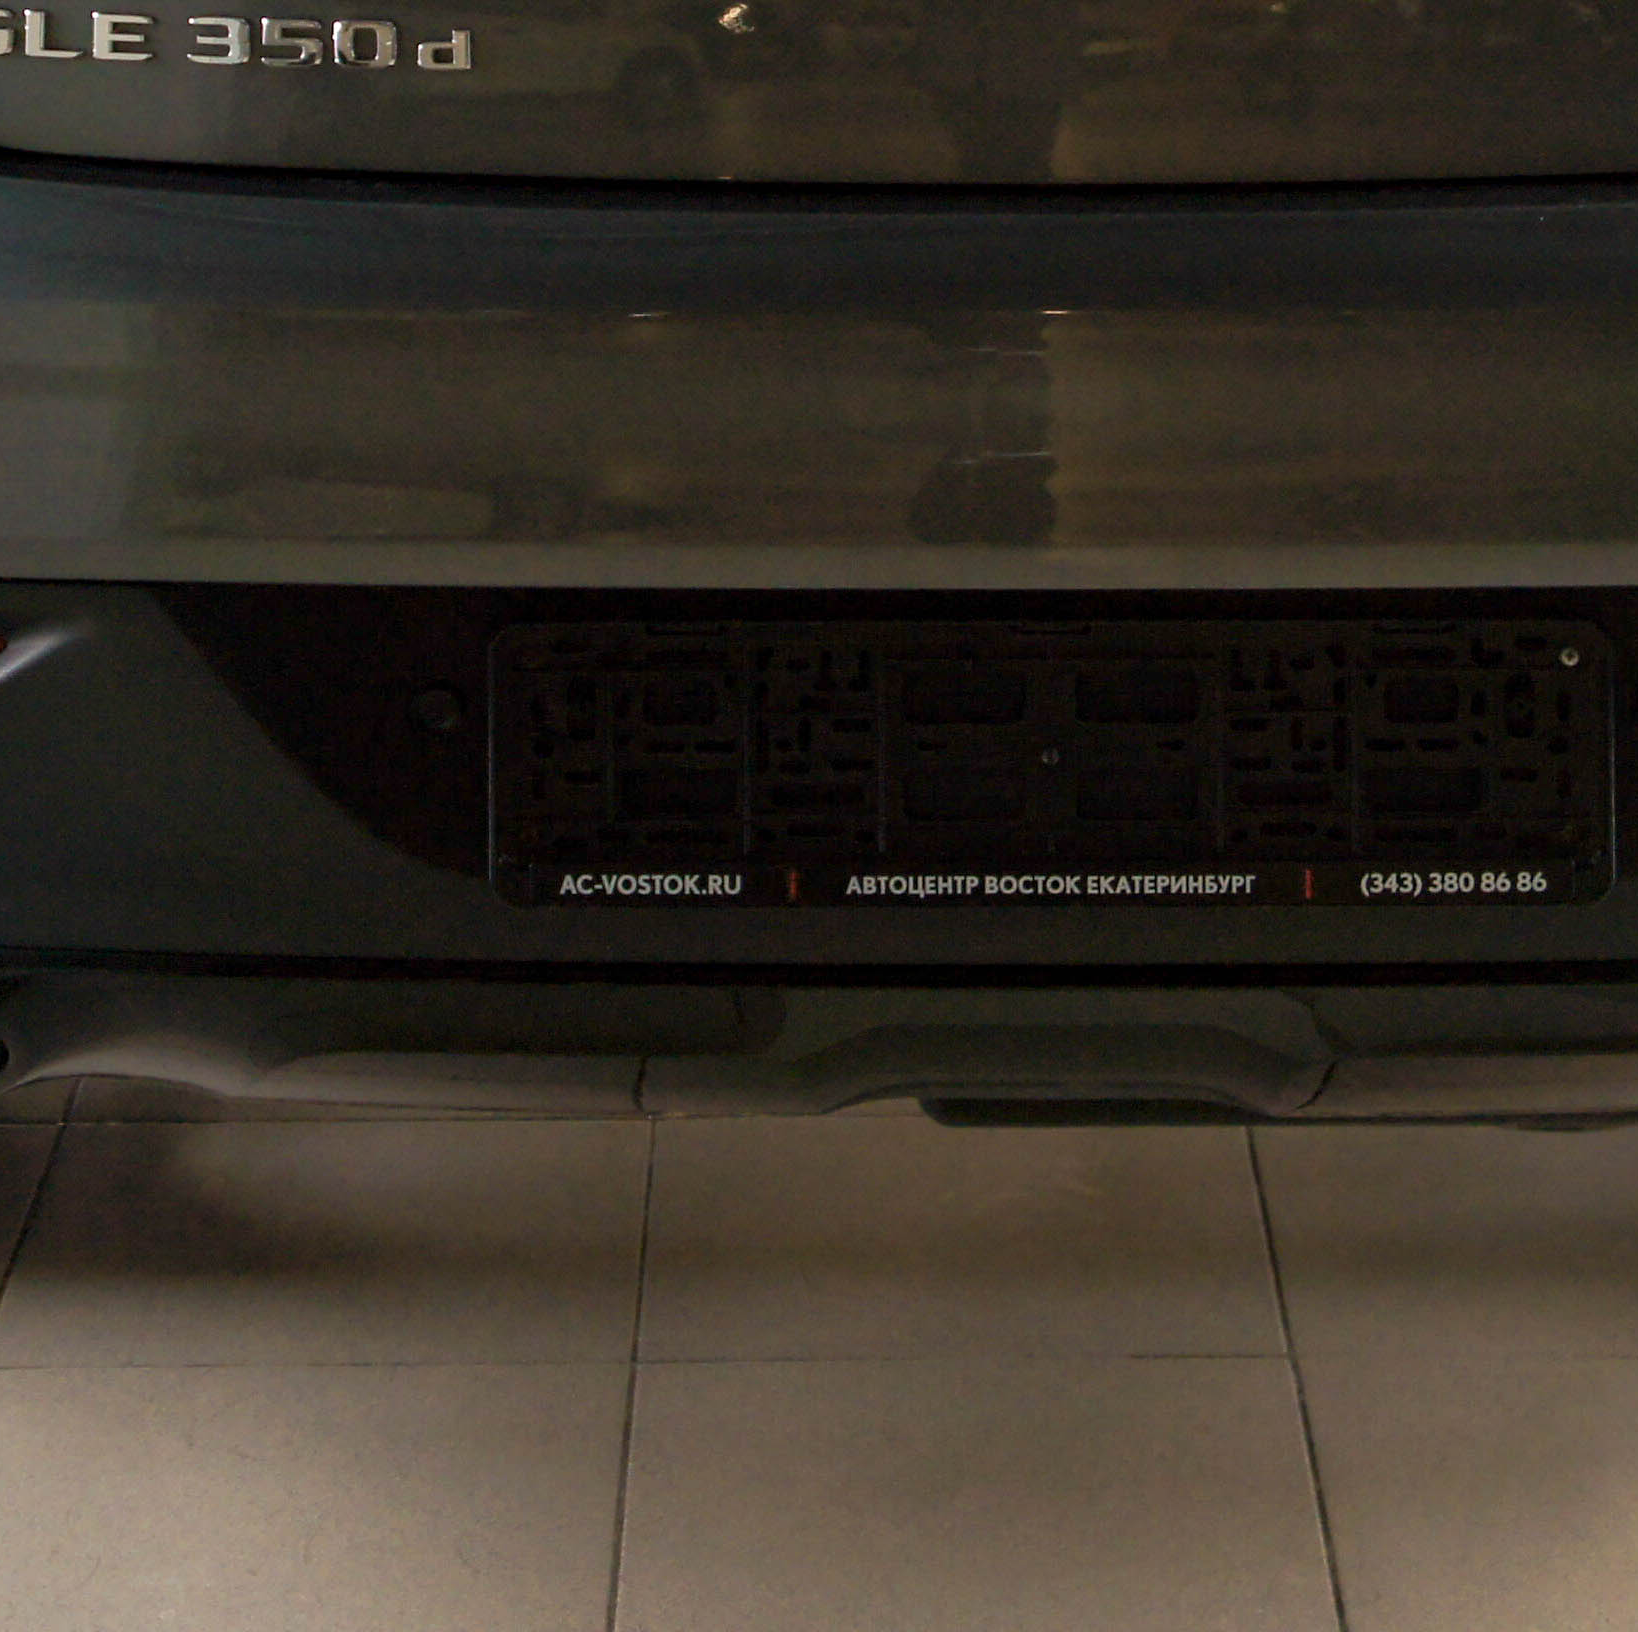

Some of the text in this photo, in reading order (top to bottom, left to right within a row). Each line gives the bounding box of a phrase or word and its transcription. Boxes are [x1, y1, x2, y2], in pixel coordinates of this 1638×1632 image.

[559, 873, 742, 896] AC-VOSTOK.RU
[846, 874, 1256, 899] АВТОЦЕНТР ВОСТОК ЕКАТЕРИНБУРГ
[1360, 870, 1548, 898] (343) 380 86 86
